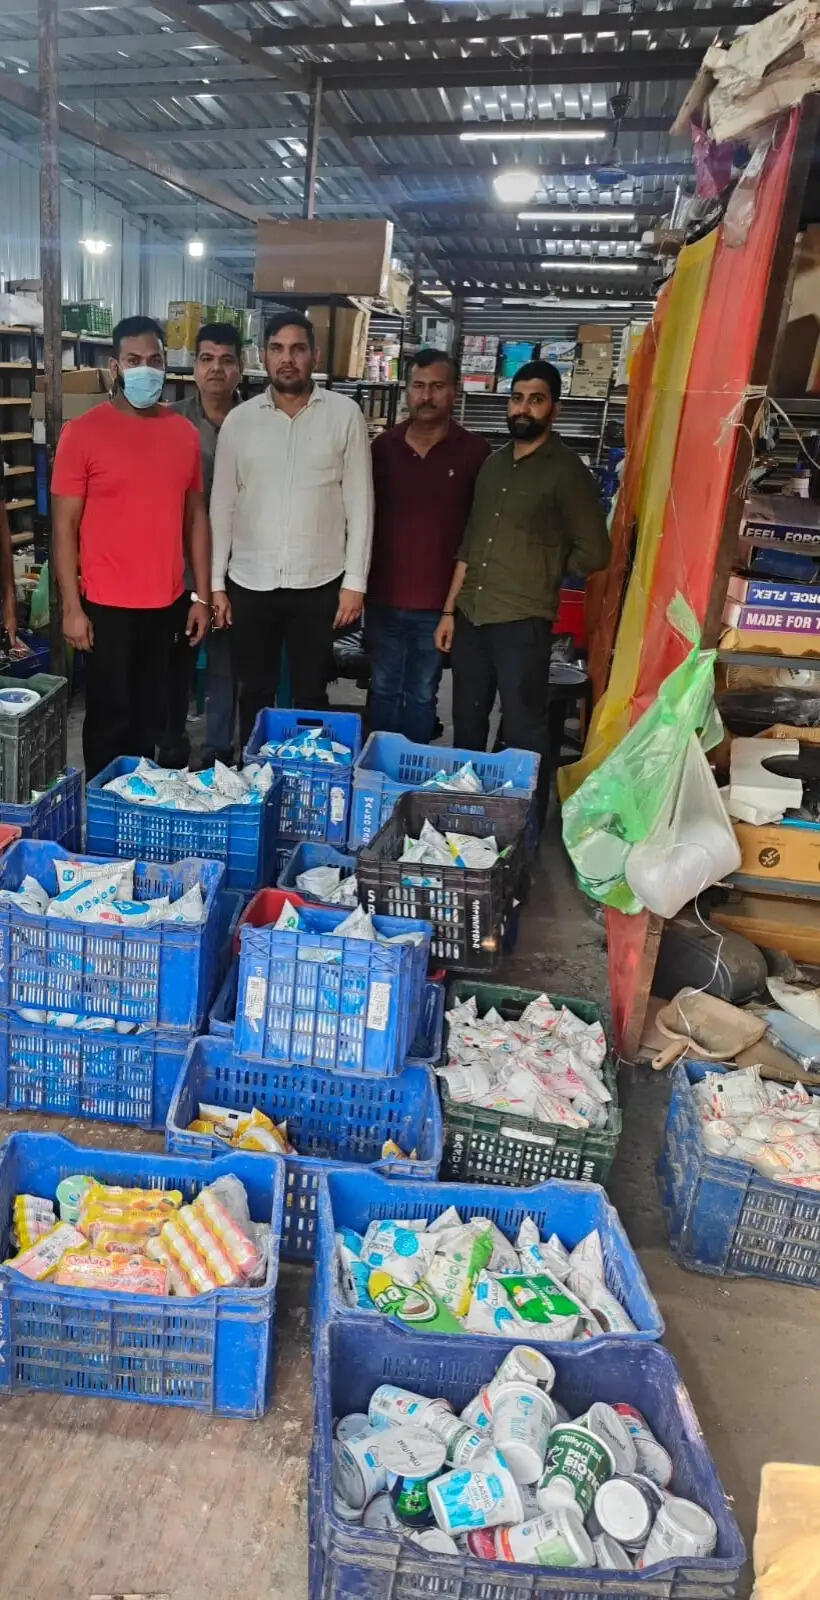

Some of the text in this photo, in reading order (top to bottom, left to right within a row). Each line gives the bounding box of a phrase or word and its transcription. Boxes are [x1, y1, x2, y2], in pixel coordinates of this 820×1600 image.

[752, 588, 787, 601] FLEX.
[746, 612, 783, 628] MADE
[786, 615, 812, 629] FOR
[567, 1448, 589, 1465] PRO
